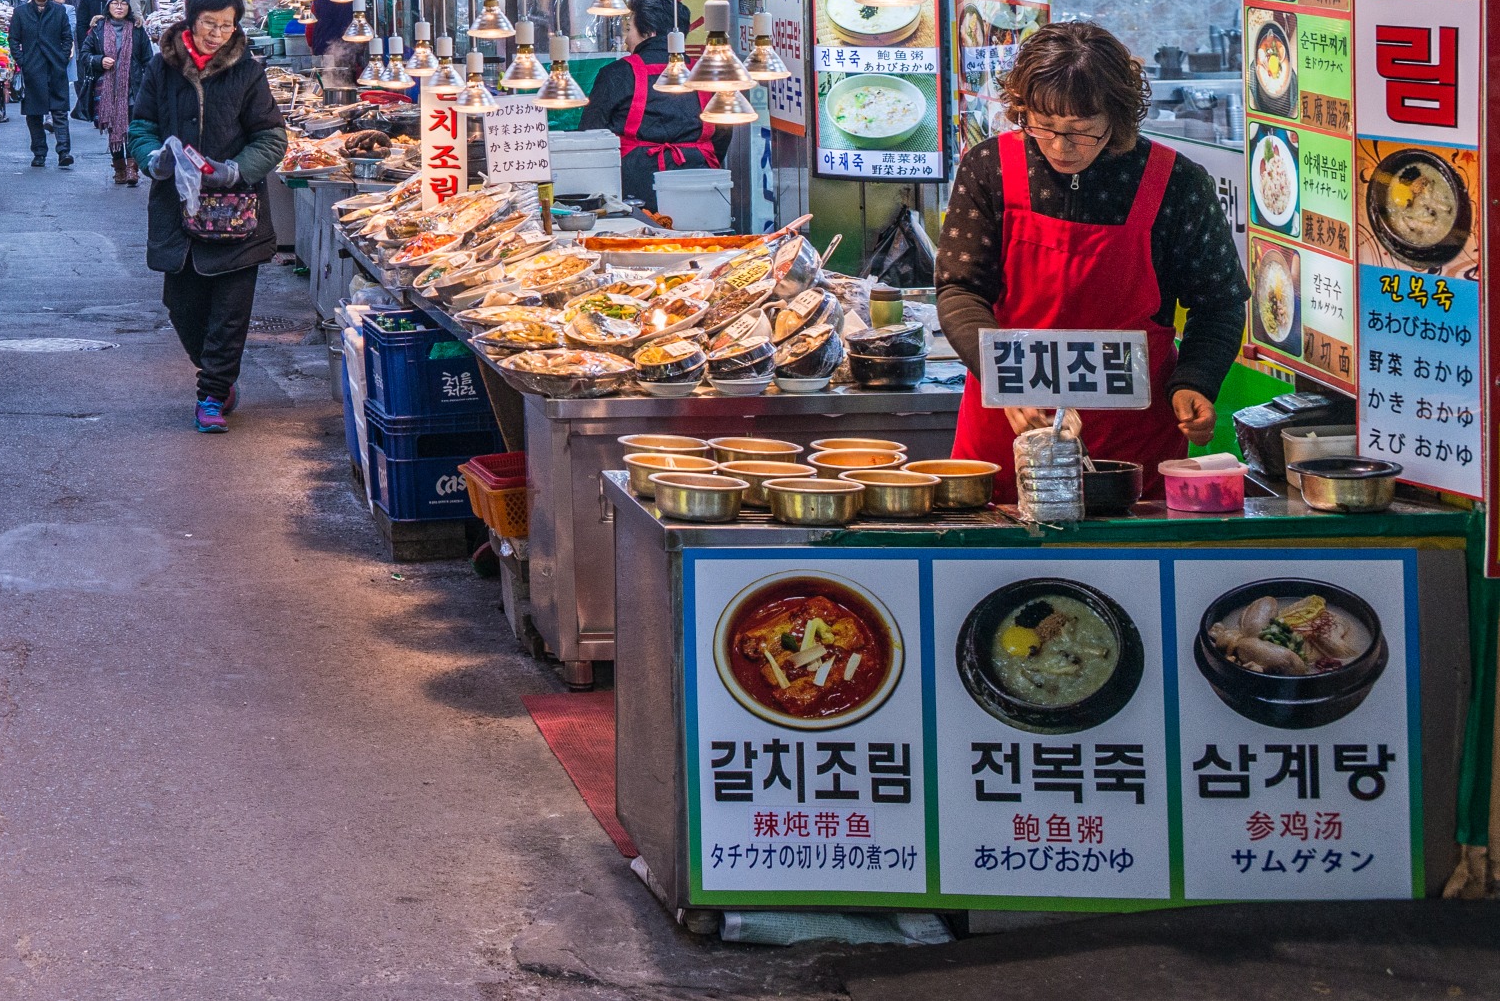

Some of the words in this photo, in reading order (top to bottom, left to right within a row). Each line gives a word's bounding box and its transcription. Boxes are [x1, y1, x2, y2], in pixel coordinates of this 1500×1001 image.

[1300, 30, 1348, 57] 순두부찌개
[821, 48, 861, 68] 전복죽
[864, 61, 935, 72] あわびおかゆ
[488, 122, 546, 136] 野菜おかゆ
[428, 93, 462, 204] 치조림
[490, 139, 548, 153] かきおかゆ
[882, 153, 926, 164] 蔬菜粥
[492, 159, 549, 173] えびおかゆ
[824, 151, 864, 171] 야채죽
[871, 164, 933, 176] 野菜おかゆ
[1303, 151, 1347, 182] 야채볶음밥
[1313, 273, 1342, 301] 칼국수
[1379, 274, 1454, 312] 전복죽
[1367, 309, 1472, 347] あわびおかゆ
[442, 371, 472, 387] 처음
[993, 340, 1134, 395] 갈치조림
[443, 385, 477, 397] 처럼
[711, 738, 912, 804] 갈치조림
[971, 742, 1146, 804] 전복죽
[1192, 743, 1397, 801] 삼계탕
[753, 811, 872, 838] 辣炖带鱼
[1012, 812, 1104, 845] 鲍鱼粥
[1246, 810, 1344, 842] 参鸡汤
[710, 843, 918, 871] タチウオの切り身の煮つけ
[973, 845, 1135, 874] あわびおかゆ
[1231, 848, 1375, 874] サムゲタン
